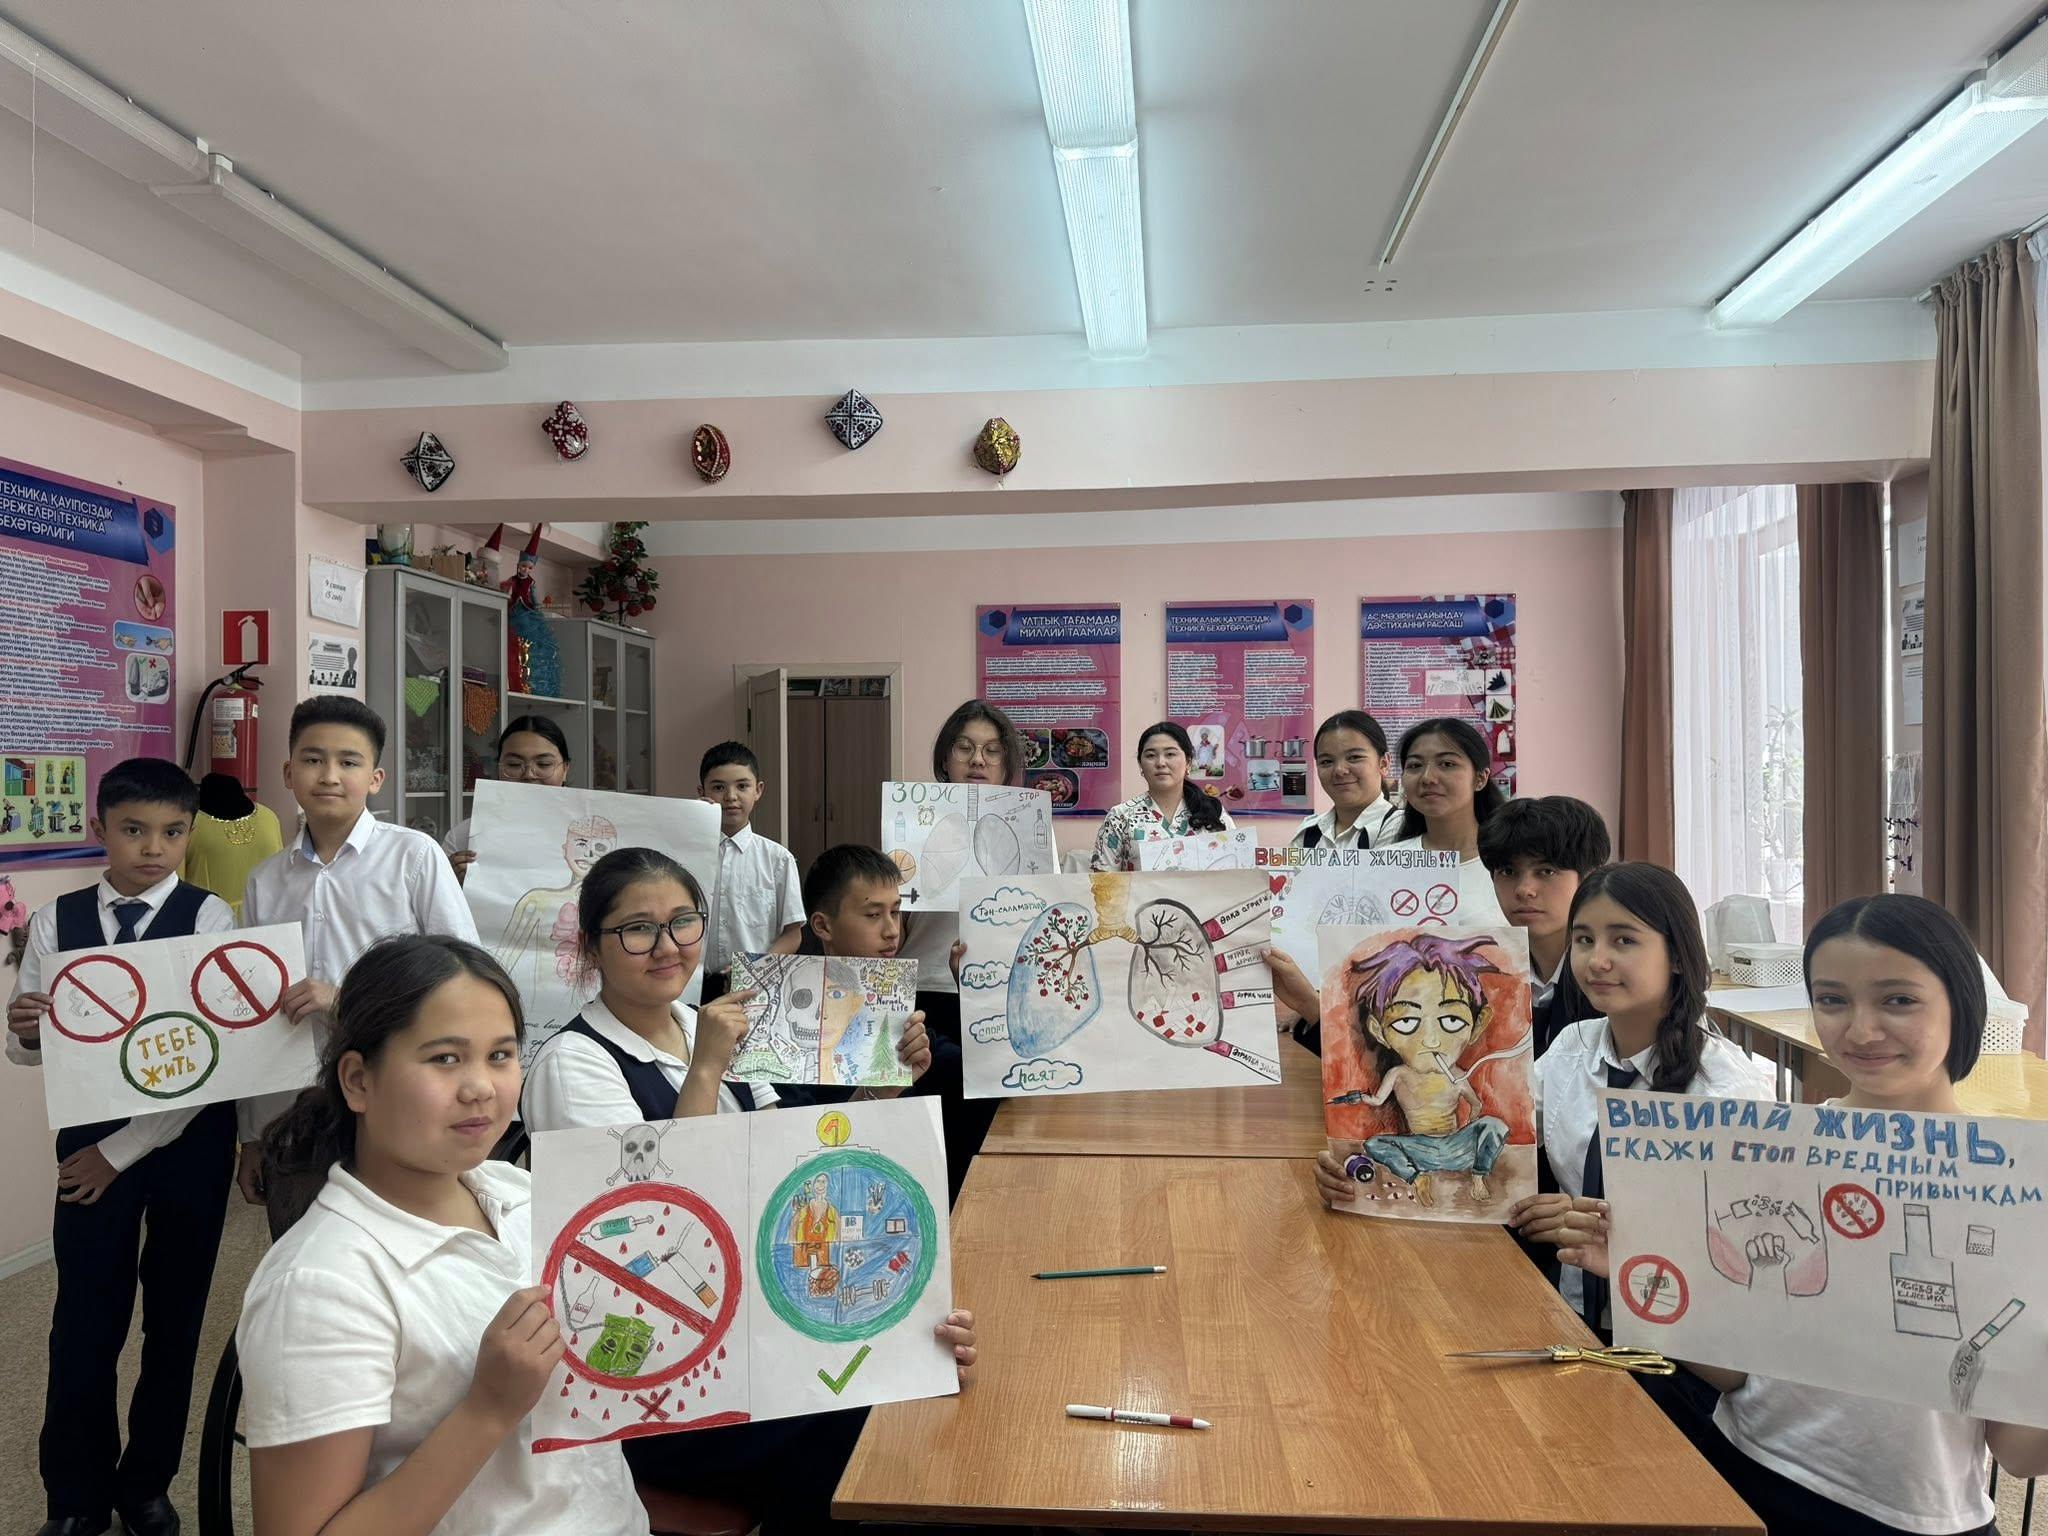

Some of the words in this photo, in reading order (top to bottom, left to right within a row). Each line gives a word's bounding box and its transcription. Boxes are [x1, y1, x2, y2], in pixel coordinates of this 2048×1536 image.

[60, 512, 106, 533] ТЕХНИКА
[1067, 627, 1117, 637] ТААМЛАР
[1018, 791, 1040, 802] STOP
[137, 1025, 197, 1060] ТЕБЕ
[1606, 1098, 1792, 1131] ВЫБИРАЙ
[1812, 1107, 2016, 1169] ЖИЗНЬ,
[1606, 1137, 1714, 1161] СКАЖИ
[1731, 1140, 1795, 1164] СТОП
[1806, 1145, 1959, 1178] ВРЕДНЫМ
[1874, 1177, 2045, 1207] ПРИВЫЧКАМ
